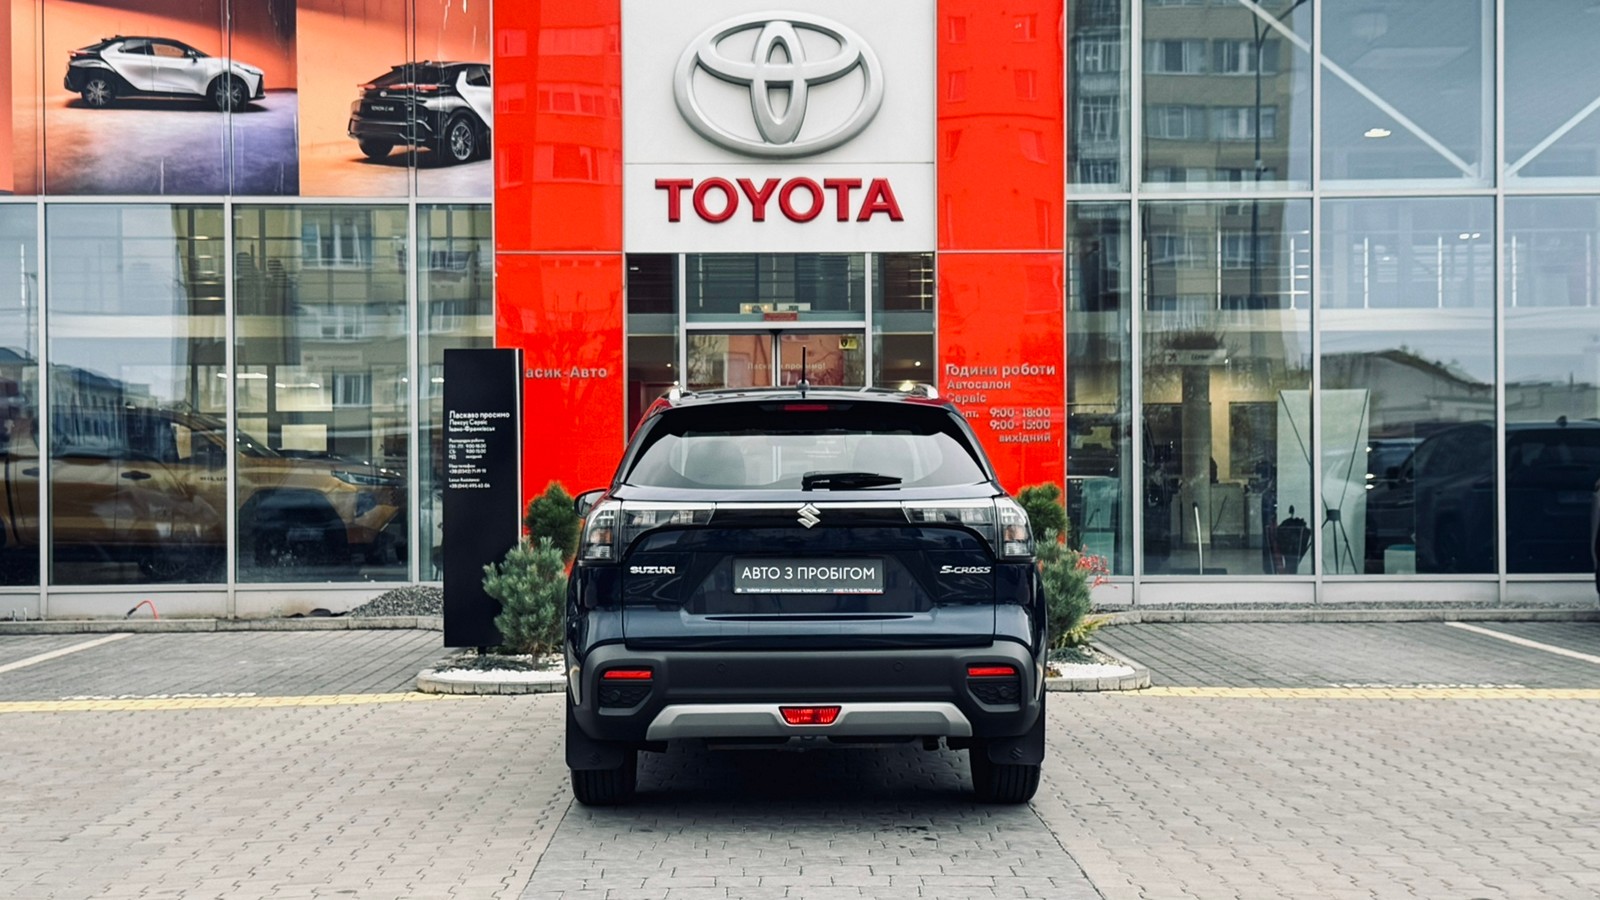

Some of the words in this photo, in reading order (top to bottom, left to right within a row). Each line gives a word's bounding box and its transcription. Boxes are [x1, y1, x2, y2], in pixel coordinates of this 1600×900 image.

[655, 177, 904, 223] TOYOTA
[945, 363, 998, 377] Години
[1002, 362, 1056, 379] роботи
[947, 381, 1011, 390] Автосалон
[947, 392, 987, 405] Сервіс
[480, 411, 510, 419] просимо
[999, 432, 1051, 443] вихідний
[629, 566, 676, 575] SUZUKI
[741, 566, 781, 580] АВТО
[784, 566, 793, 580] З
[797, 566, 875, 580] ПРОБІГОМ
[939, 565, 992, 574] S-CROSS
